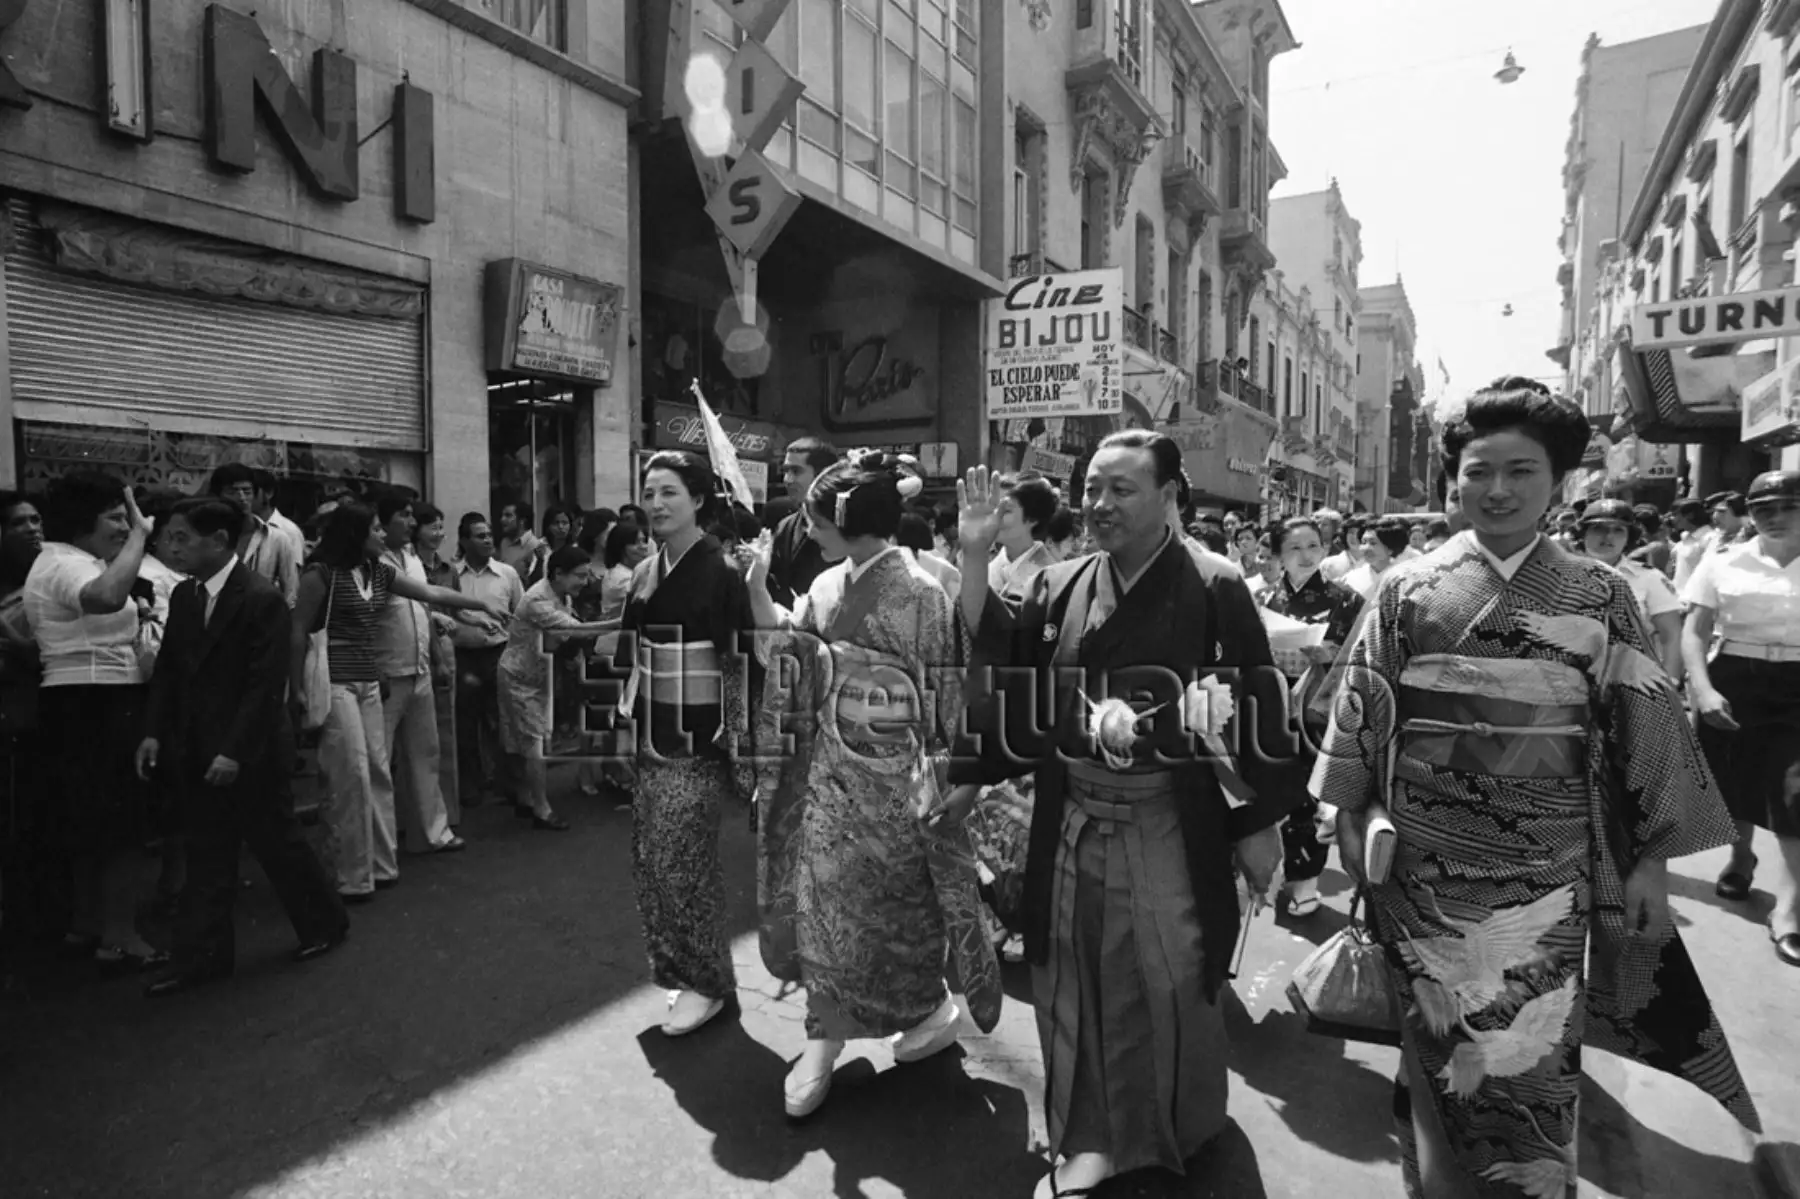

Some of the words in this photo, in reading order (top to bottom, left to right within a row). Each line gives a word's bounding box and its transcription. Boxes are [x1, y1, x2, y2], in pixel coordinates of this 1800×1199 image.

[1004, 276, 1103, 311] Cine
[999, 311, 1110, 348] BIJOU
[1646, 294, 1800, 338] TURN
[990, 368, 1005, 387] EL
[1007, 365, 1043, 385] CIELO
[1045, 362, 1081, 382] PUEDE
[1003, 385, 1061, 405] ESPERAR
